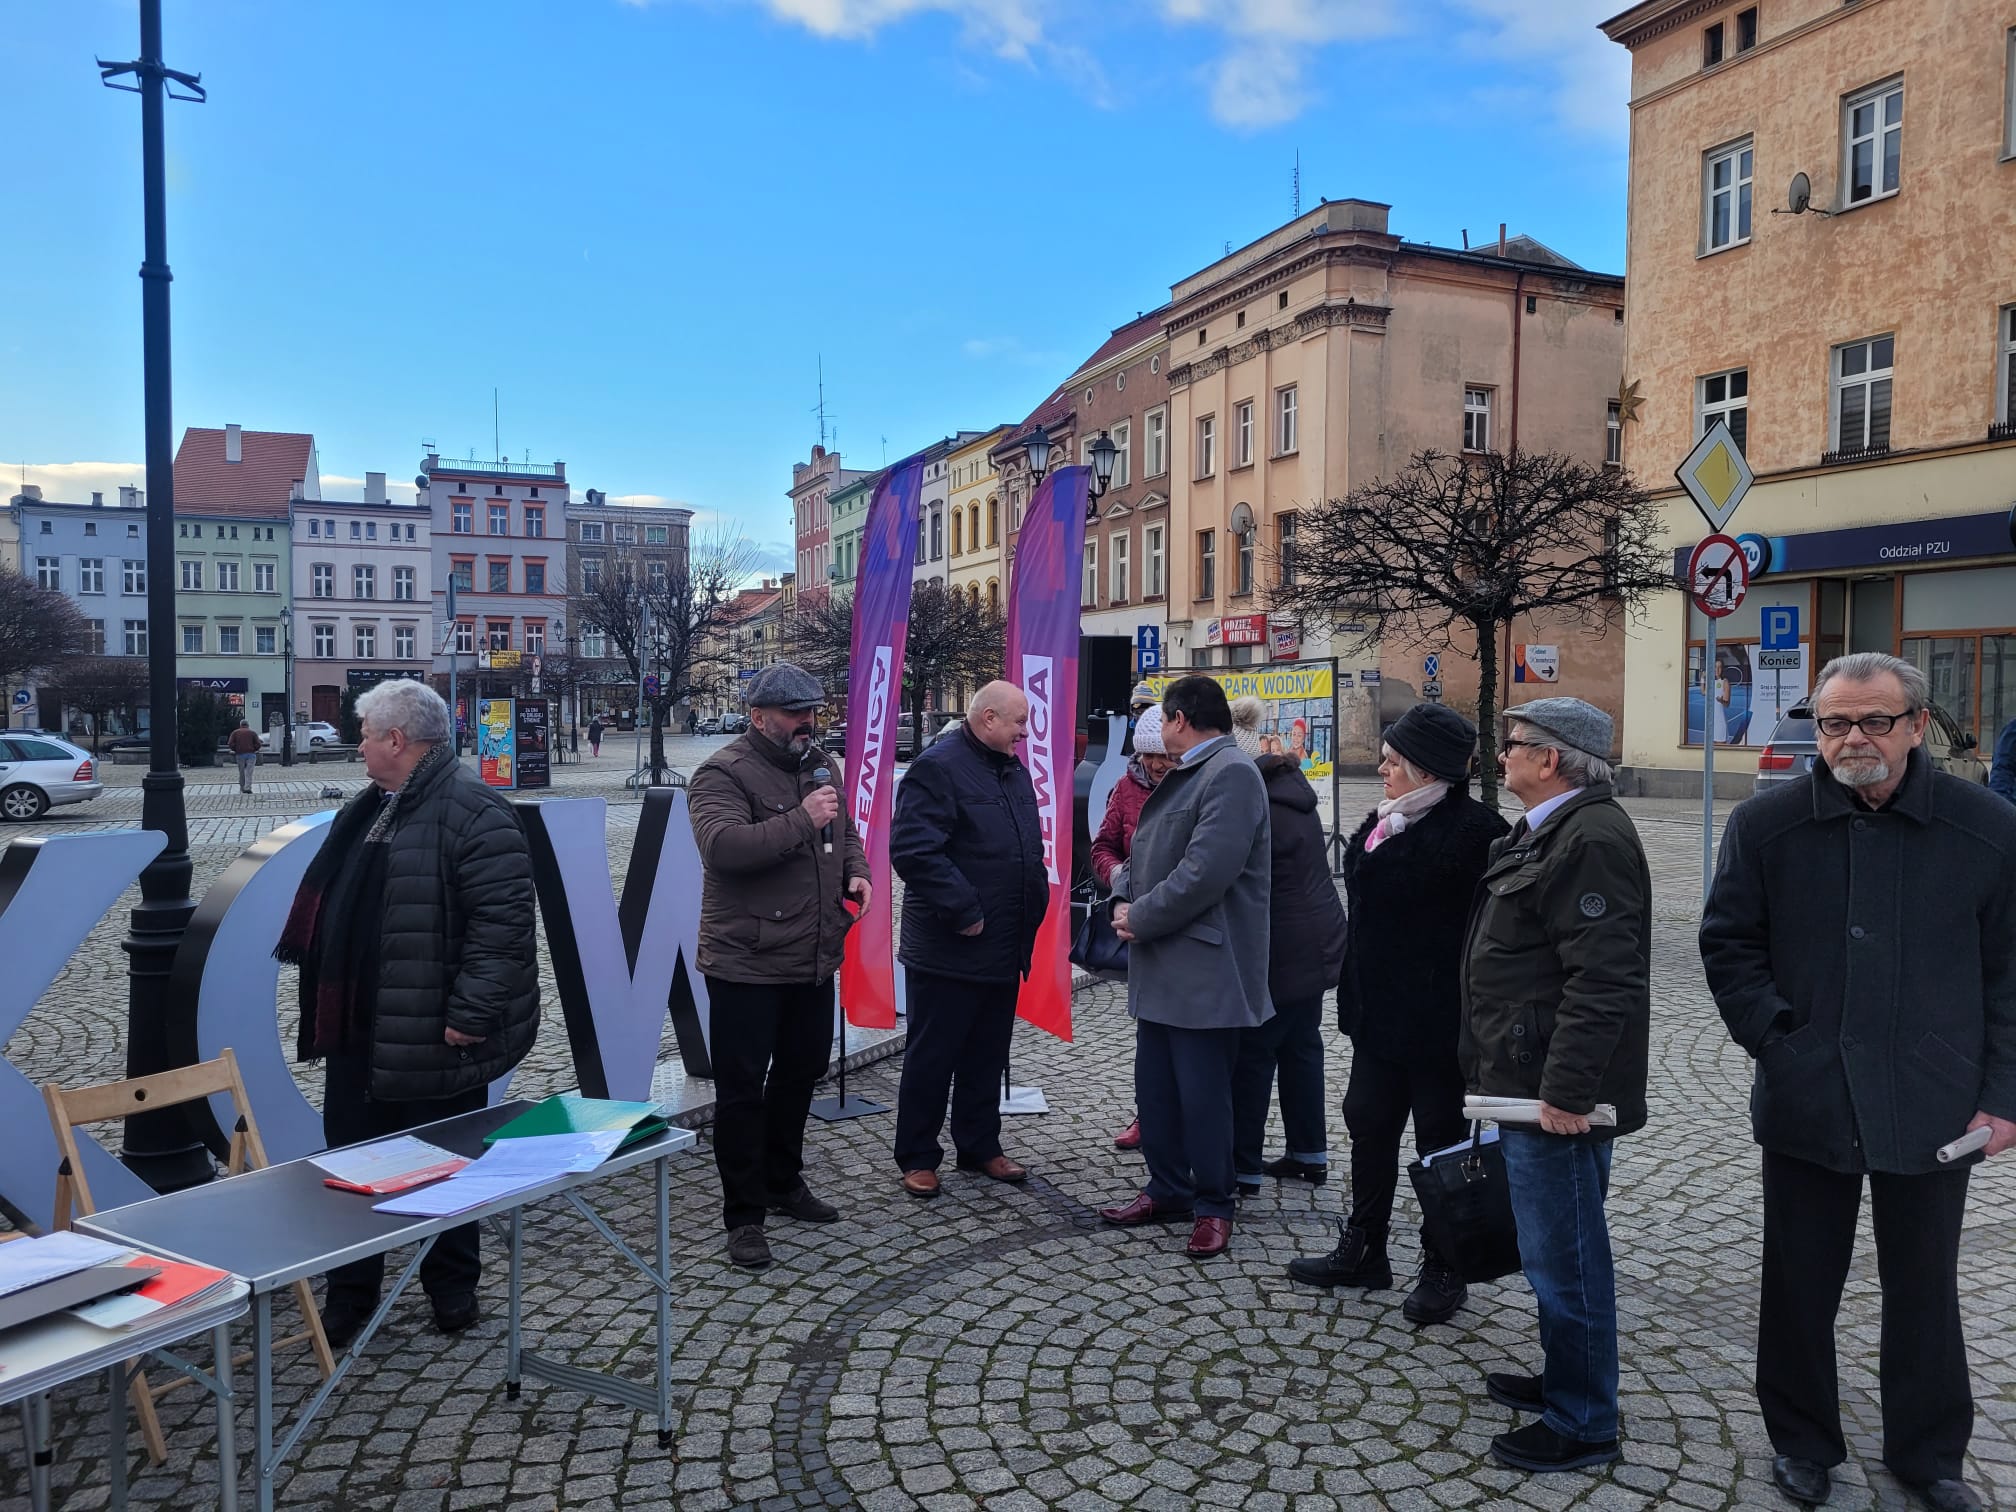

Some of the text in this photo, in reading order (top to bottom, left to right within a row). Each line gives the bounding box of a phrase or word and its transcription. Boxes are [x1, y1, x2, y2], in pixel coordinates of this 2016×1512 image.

[1880, 541, 1950, 559] Oddział PZU
[1229, 629, 1260, 642] OBUWIE
[1769, 611, 1791, 645] P
[1276, 632, 1293, 643] MINI
[1142, 651, 1155, 668] P
[1760, 655, 1799, 666] Koniec
[191, 680, 230, 688] PLAY
[1225, 677, 1259, 698] PARK
[1263, 673, 1315, 695] WODNY
